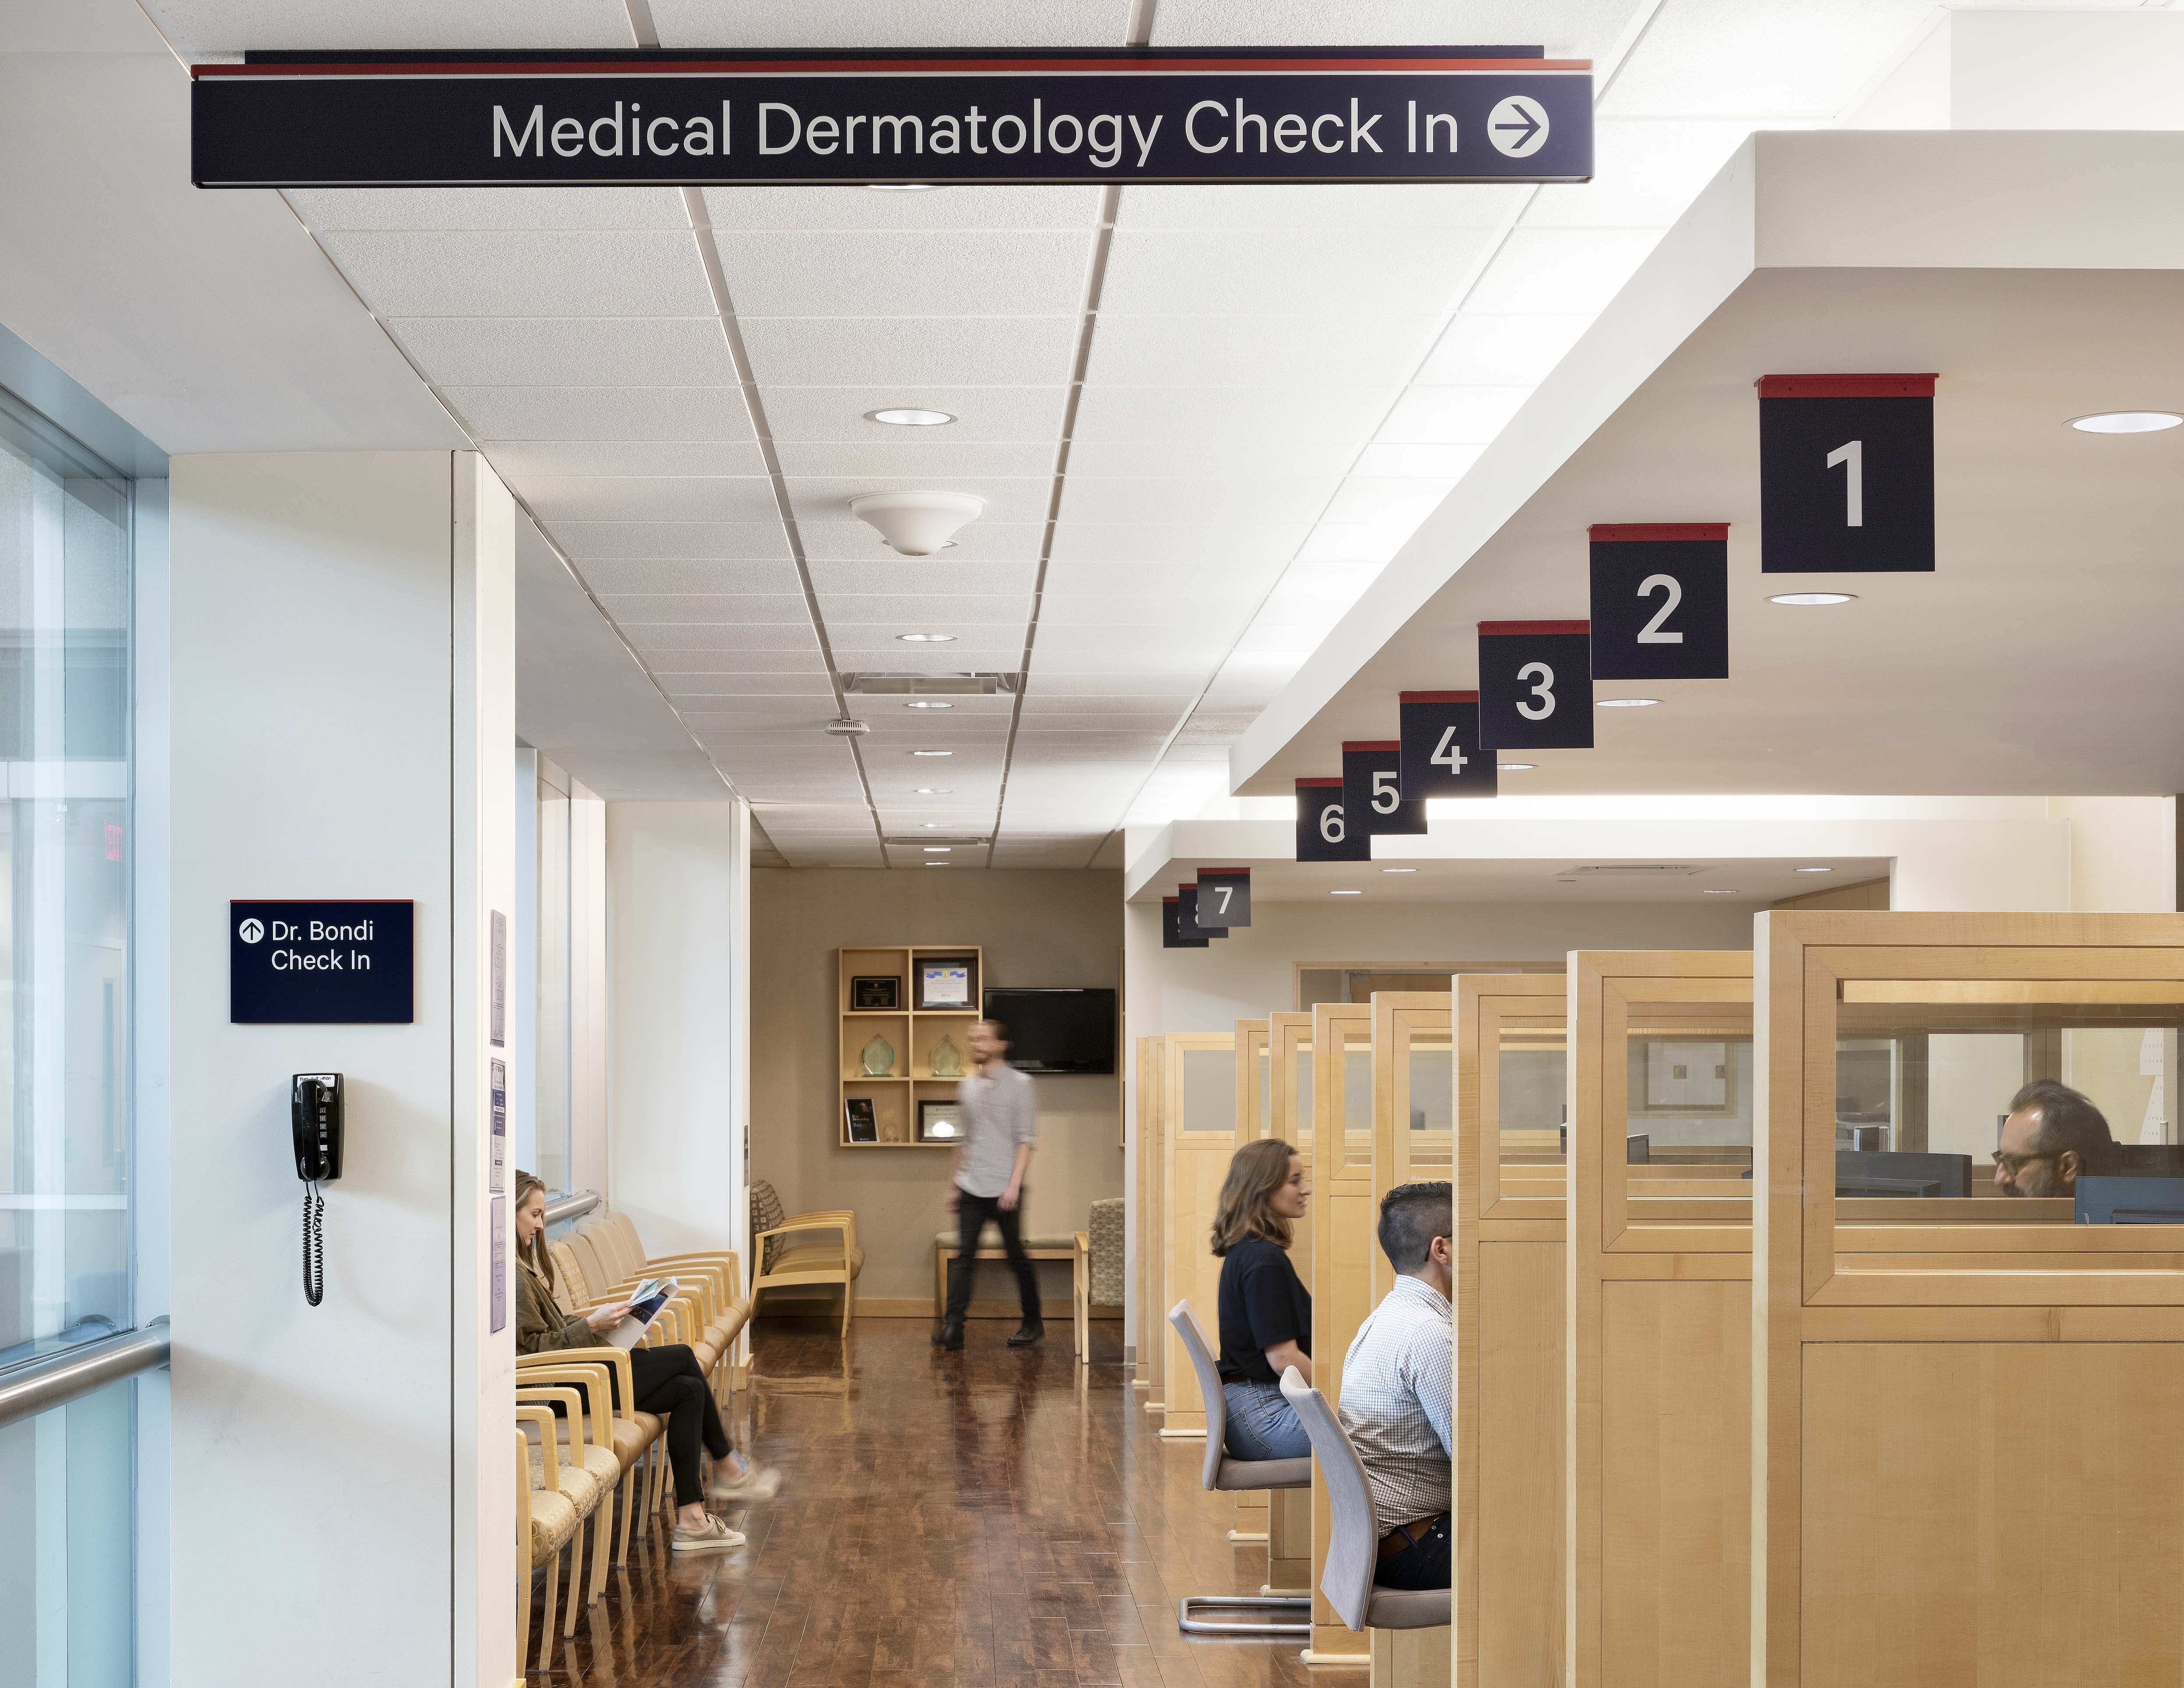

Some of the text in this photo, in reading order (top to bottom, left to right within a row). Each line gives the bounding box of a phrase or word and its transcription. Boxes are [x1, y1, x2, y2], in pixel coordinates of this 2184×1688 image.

[493, 97, 1458, 168] Medical Dermatology Check In
[1826, 440, 1863, 527] 1
[1636, 573, 1684, 644] 2
[1515, 661, 1556, 721] 3
[1430, 726, 1468, 775] 4
[1371, 771, 1400, 814] 5
[1319, 804, 1345, 843] 6
[1214, 887, 1233, 914] 7
[272, 919, 373, 941] Dr. Bondi
[271, 949, 370, 970] Check In
